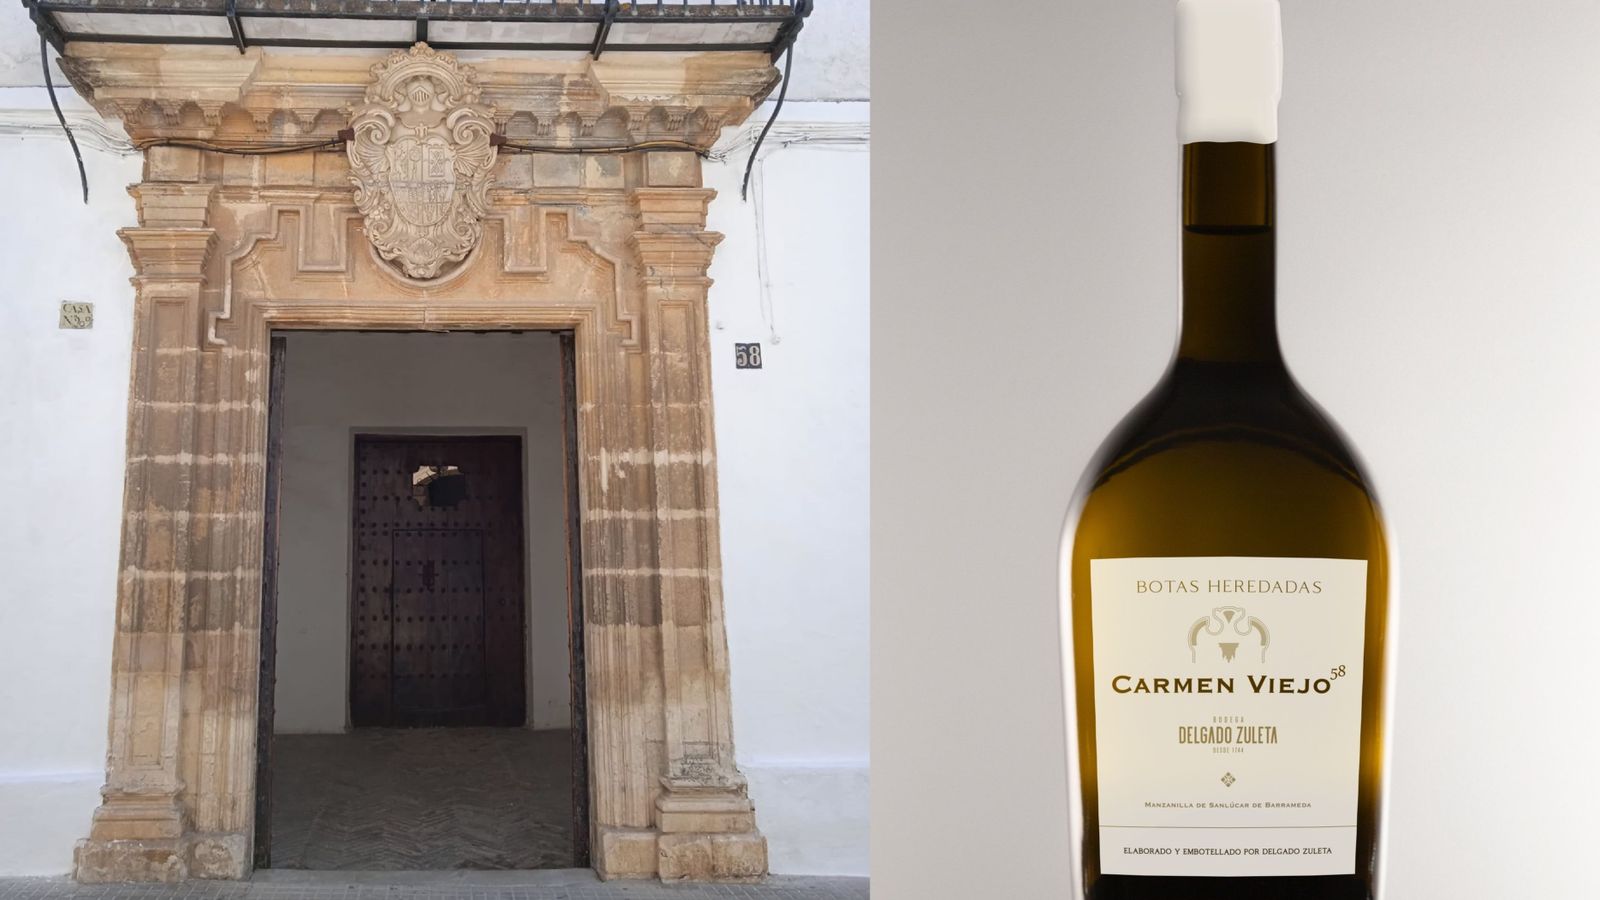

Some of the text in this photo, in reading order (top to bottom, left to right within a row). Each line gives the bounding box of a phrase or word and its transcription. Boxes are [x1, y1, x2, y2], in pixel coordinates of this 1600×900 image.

[63, 303, 91, 313] CASA
[736, 345, 761, 367] 58
[1136, 579, 1322, 594] BOTAS HEREDADAS
[1111, 675, 1235, 694] CARMEN
[1179, 726, 1278, 744] DELGADO ZULETA
[1123, 847, 1172, 855] ELABORADO
[1183, 848, 1241, 856] EMBOTELLADO
[1244, 848, 1260, 856] POR
[1262, 847, 1300, 855] DELGADO
[1303, 847, 1333, 855] ZULETA
